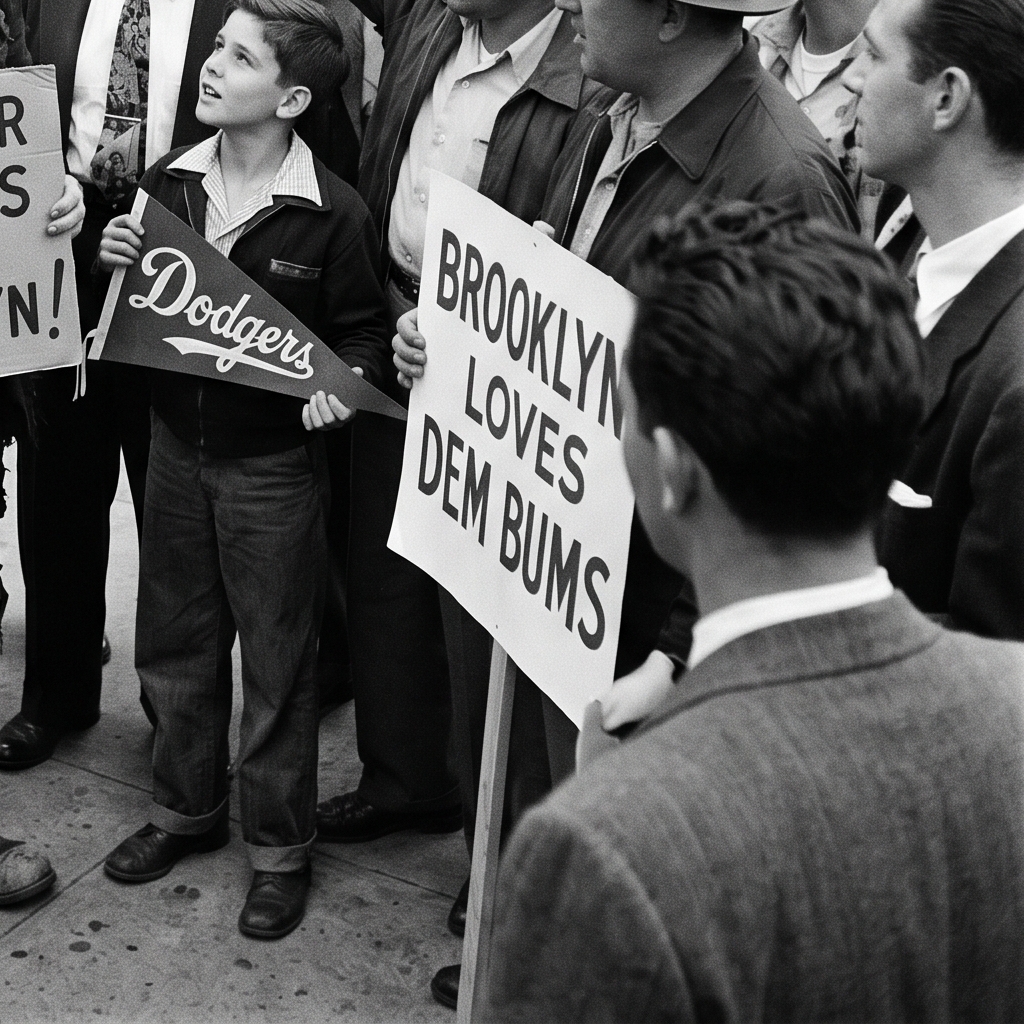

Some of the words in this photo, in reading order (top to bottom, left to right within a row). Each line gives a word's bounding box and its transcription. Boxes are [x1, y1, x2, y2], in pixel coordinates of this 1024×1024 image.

[128, 246, 314, 374] Dodgers
[436, 228, 625, 441] BROOKLYN
[464, 355, 588, 505] LOVES
[417, 414, 492, 546] DEM
[499, 481, 611, 651] BUMS
